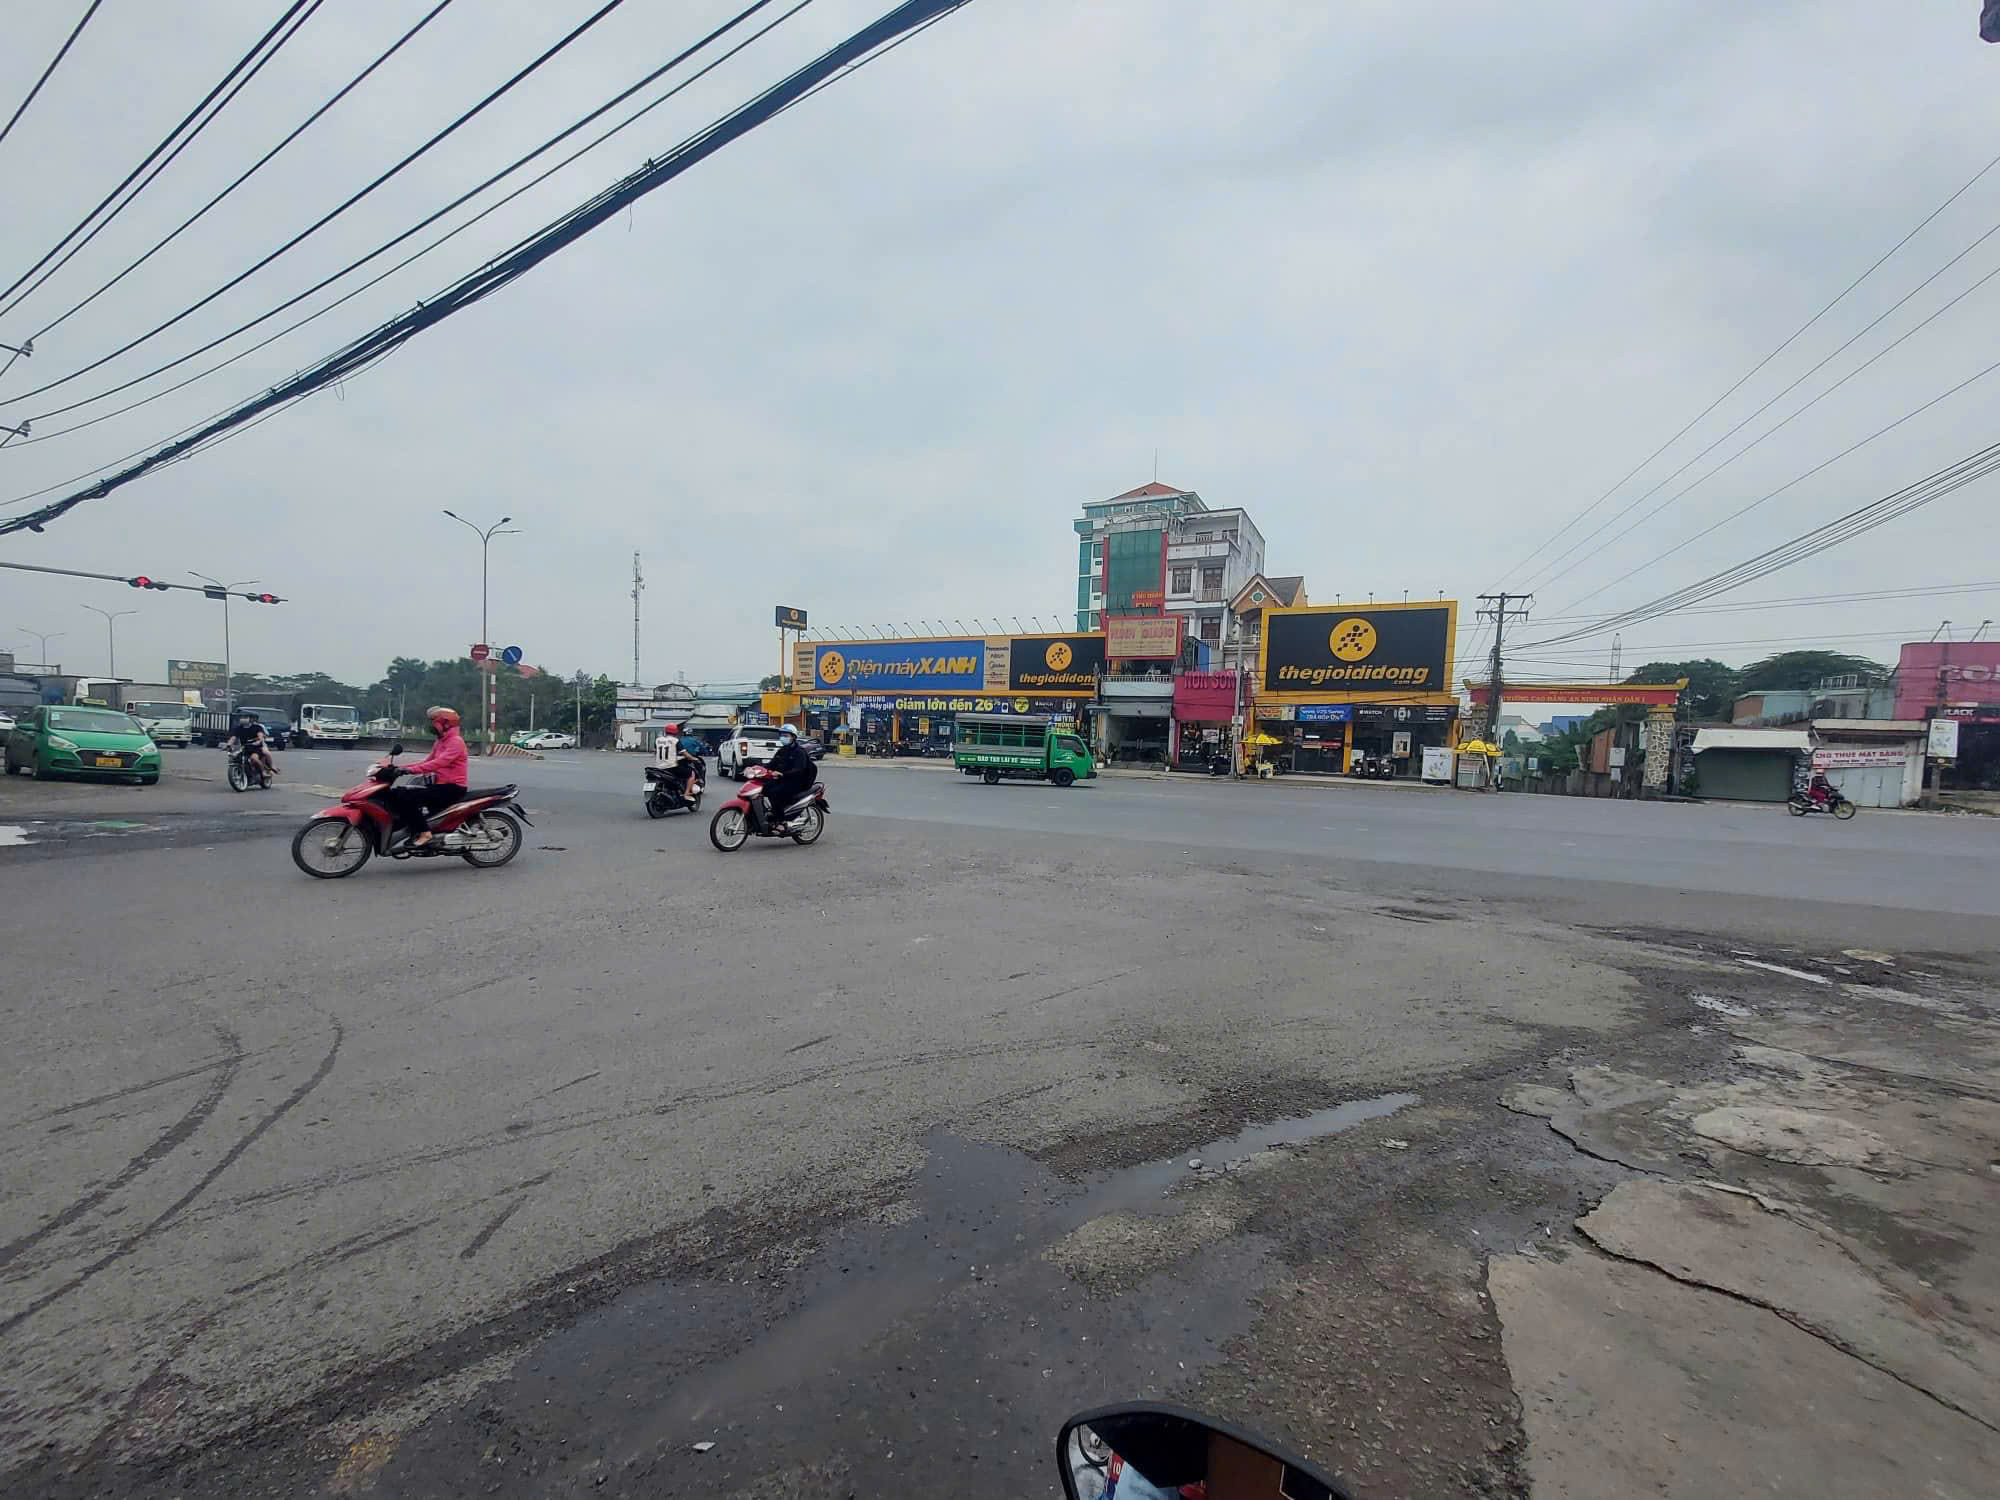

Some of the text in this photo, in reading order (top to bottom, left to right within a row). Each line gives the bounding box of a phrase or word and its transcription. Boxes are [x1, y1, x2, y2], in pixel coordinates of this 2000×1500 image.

[885, 658, 920, 679] máy
[918, 656, 977, 674] XANH
[1278, 665, 1429, 685] thegioididong
[895, 697, 926, 710] Giảm
[658, 746, 669, 760] 11
